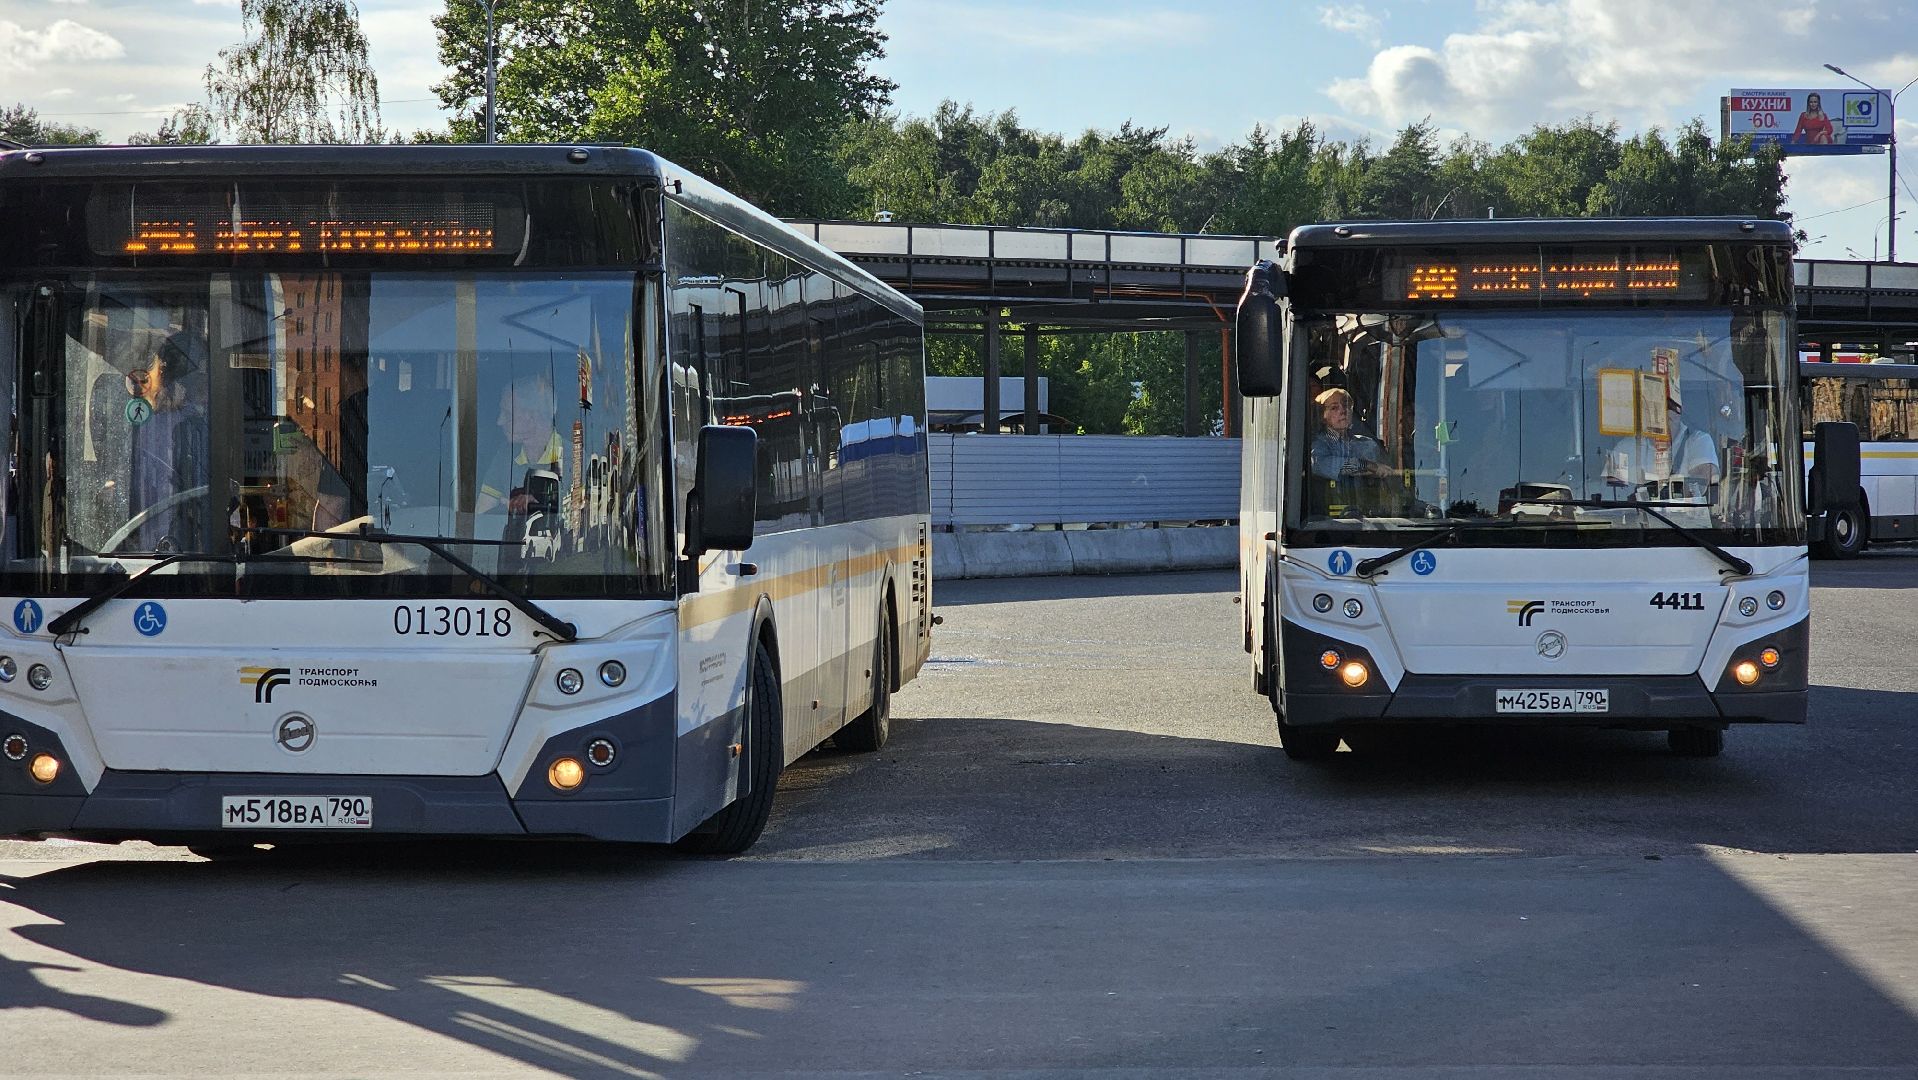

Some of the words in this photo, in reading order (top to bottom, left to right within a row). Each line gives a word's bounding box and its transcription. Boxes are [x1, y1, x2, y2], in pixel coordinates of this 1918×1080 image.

[1741, 98, 1787, 110] КУХНИ
[1650, 592, 1705, 611] 4411
[393, 605, 512, 637] 013018
[299, 668, 360, 677] ТРАНСПОРТ
[298, 678, 378, 687] ПОДМОСКОВЬЯ
[1577, 691, 1604, 705] 790
[328, 798, 365, 817] 790
[337, 816, 356, 825] RUS
